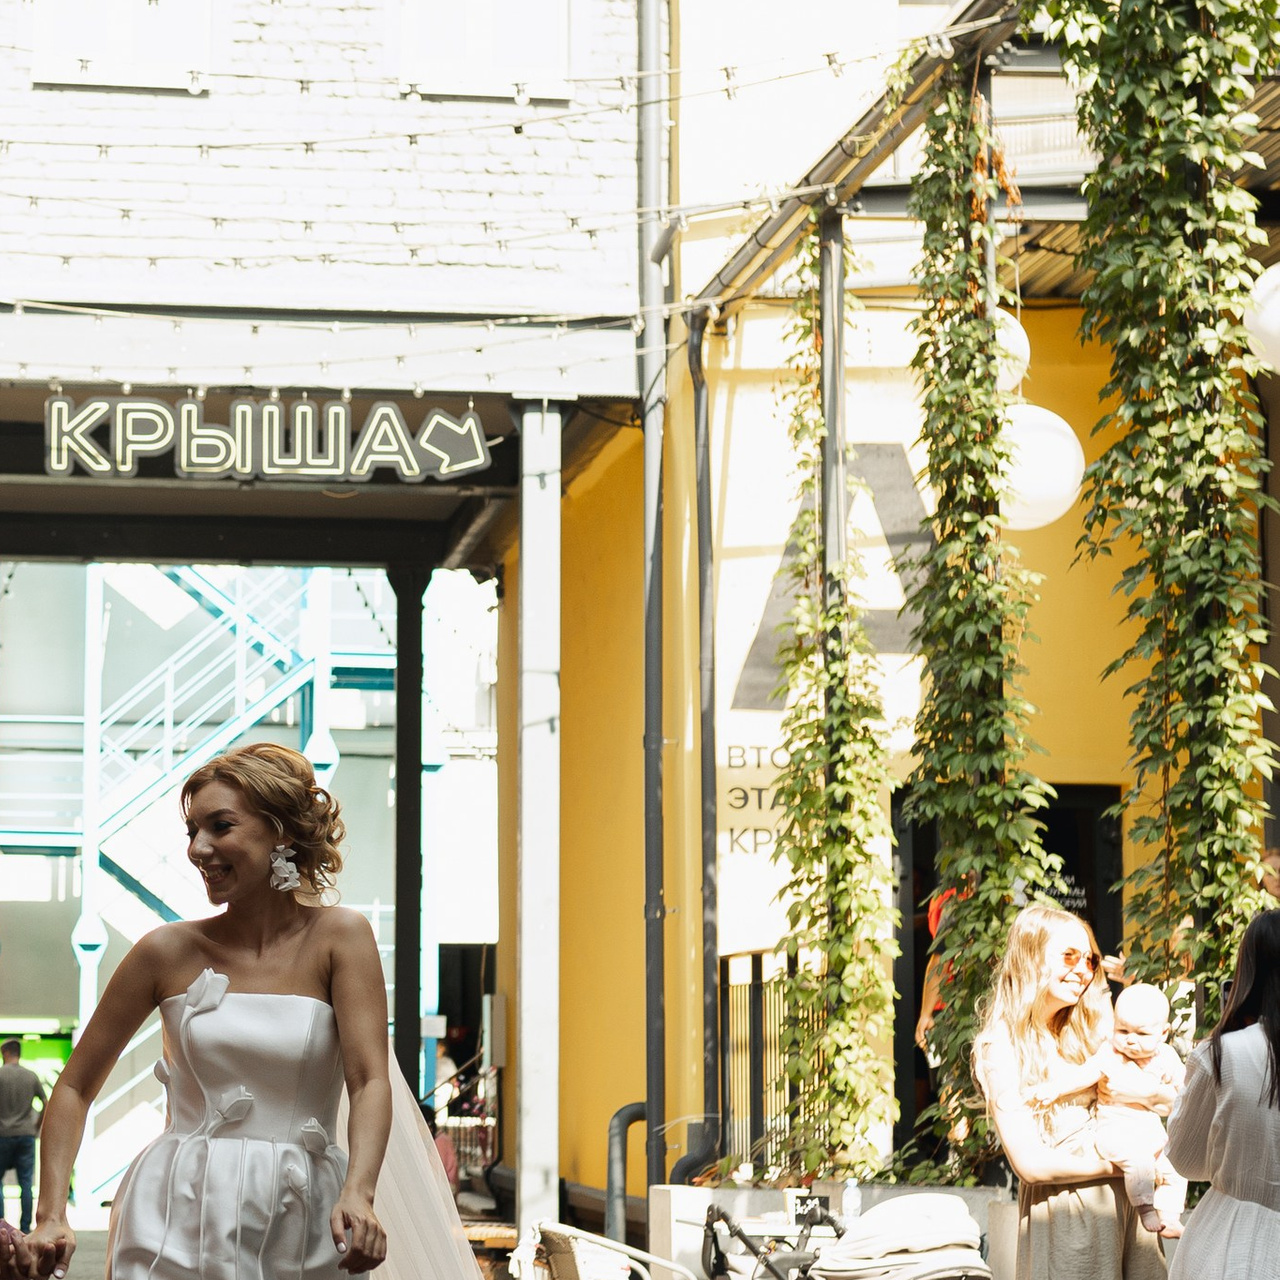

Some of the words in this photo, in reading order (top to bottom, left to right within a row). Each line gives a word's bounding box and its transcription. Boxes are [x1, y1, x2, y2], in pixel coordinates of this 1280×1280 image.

[50, 400, 421, 476] КРЫША
[727, 745, 794, 770] ВТО
[727, 786, 788, 811] ЭТА
